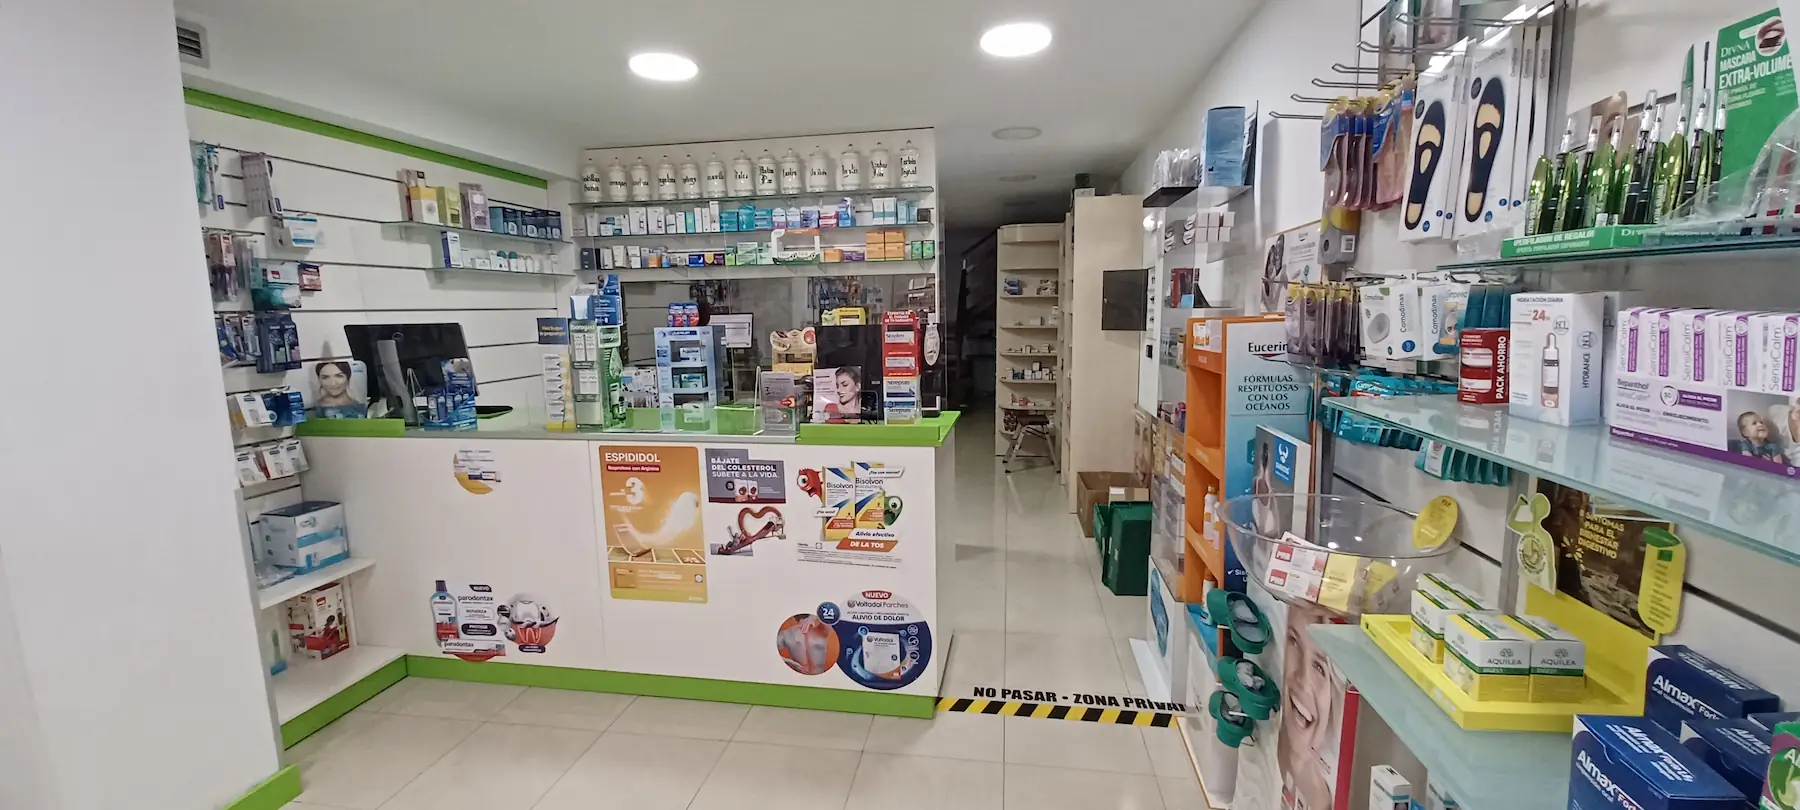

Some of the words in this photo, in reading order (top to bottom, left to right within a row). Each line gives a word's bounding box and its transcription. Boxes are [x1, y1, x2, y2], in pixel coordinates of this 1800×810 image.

[1720, 40, 1750, 58] DIVNA
[1719, 54, 1793, 89] EXTRA-VOLUME
[1720, 50, 1757, 73] MASCARA
[1554, 233, 1563, 242] DE
[1532, 310, 1545, 321] 24
[1497, 335, 1507, 374] AHORRO
[1619, 319, 1629, 372] SensiCalm
[1648, 321, 1657, 377] SensiCalm
[1682, 323, 1692, 382] SensiCalm
[1723, 324, 1733, 387] SensiCalm
[1769, 326, 1782, 392] SensiCalm
[1244, 374, 1293, 383] FÓRMULAS
[1582, 353, 1591, 388] HYDRANCE
[1238, 383, 1299, 393] RESPETUOSAS
[1248, 393, 1269, 402] CON
[1271, 393, 1288, 401] LOS
[1495, 376, 1505, 400] PACK
[1245, 401, 1291, 411] OCÉANOS
[605, 452, 661, 463] ESPIDIDOL
[711, 456, 740, 464] BÁJATE
[626, 477, 645, 504] 3
[855, 477, 884, 485] Bisolvon
[1579, 527, 1619, 550] BIENESTAR
[1584, 521, 1605, 535] PARA
[1606, 529, 1616, 539] EL
[1577, 536, 1617, 560] DIGESTIVO
[822, 608, 835, 616] 24
[1487, 658, 1522, 666] AQUILEA
[1541, 658, 1576, 666] AQUILEA
[973, 686, 996, 698] NO
[1001, 688, 1057, 702] PASAR
[1073, 693, 1119, 707] ZONA
[1653, 674, 1698, 710] Almax
[1577, 749, 1616, 796] Almax
